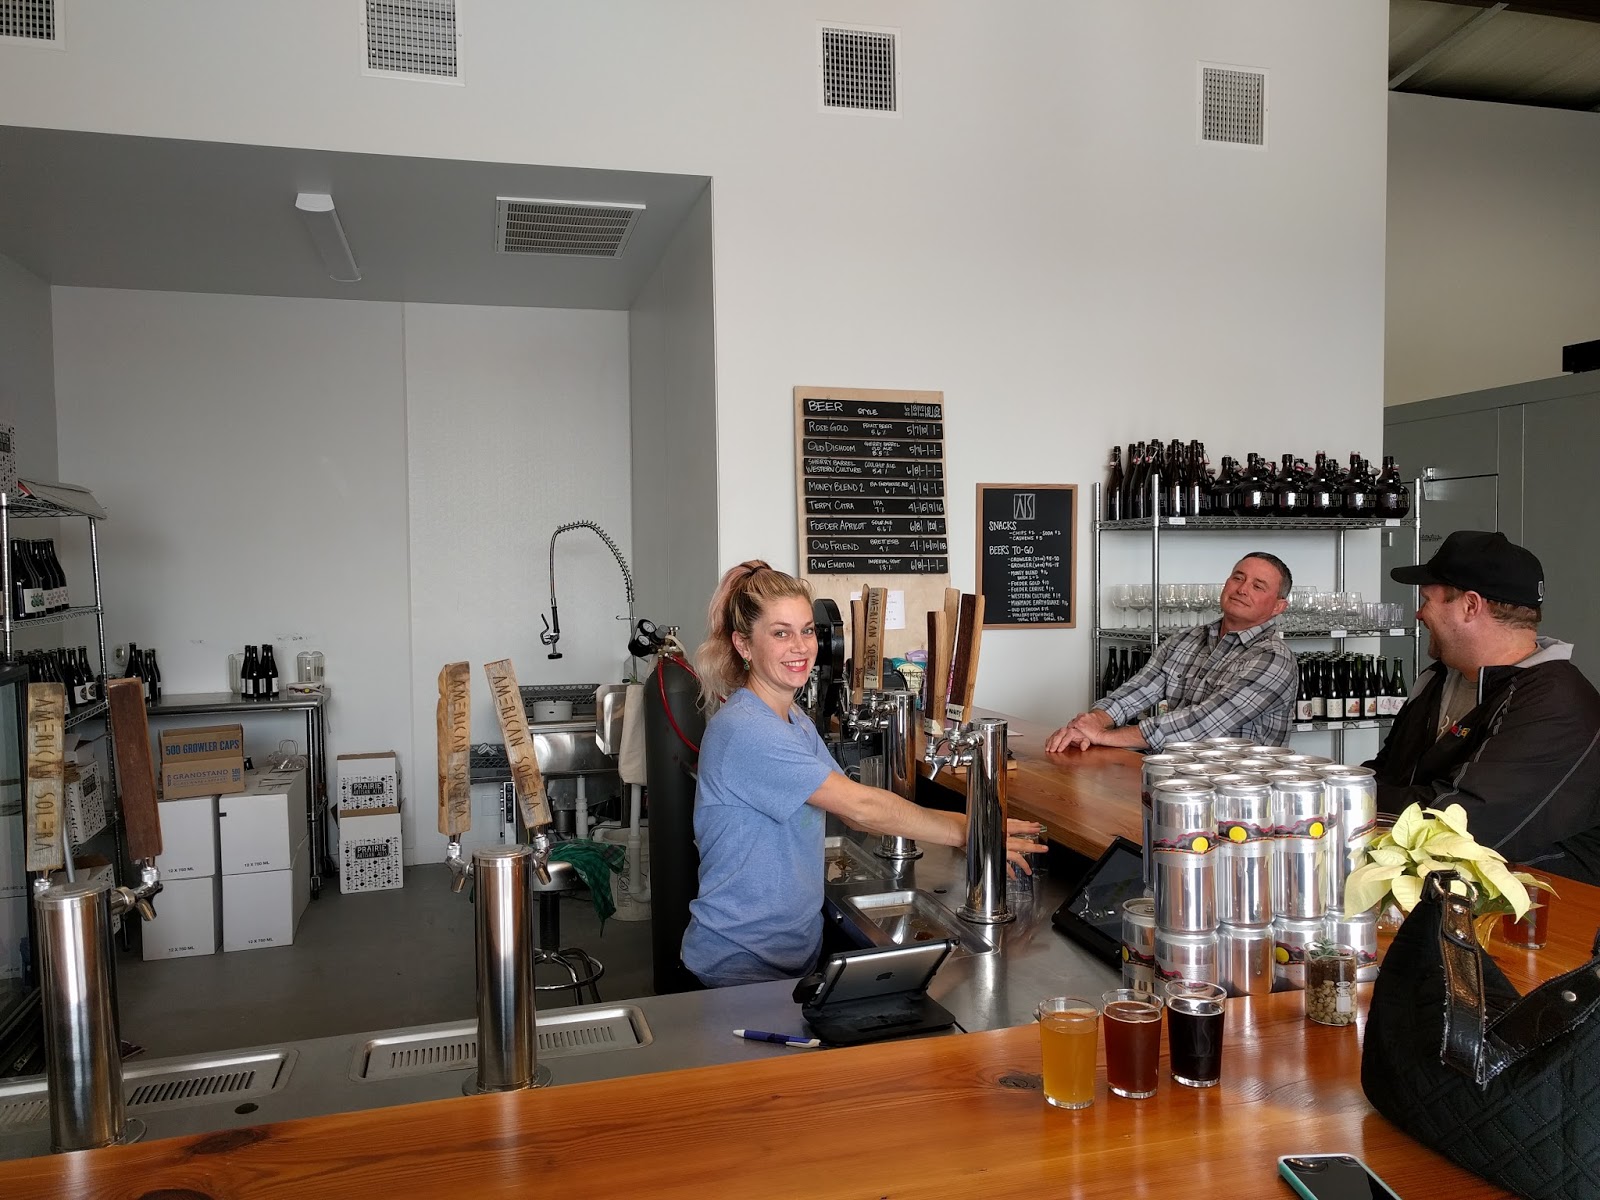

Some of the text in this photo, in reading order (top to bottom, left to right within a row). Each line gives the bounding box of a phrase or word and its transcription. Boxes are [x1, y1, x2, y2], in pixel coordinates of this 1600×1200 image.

[808, 401, 843, 411] BEER
[857, 408, 878, 416] STYLE
[809, 421, 848, 432] ROSE GOLD
[808, 482, 833, 491] MONEY
[834, 482, 858, 492] BLEND
[834, 500, 854, 510] CITRA
[810, 520, 867, 532] FOEDER APRICOT
[989, 521, 1017, 531] SNACKS
[830, 540, 859, 550] FRIEND
[989, 546, 1034, 554] BEERS TO-GO
[827, 559, 855, 569] EMOTION
[166, 740, 239, 755] 500 GROWLER CAPS
[492, 676, 541, 811] AMERICAN SOLERA
[452, 680, 467, 819] AMERICAN SOLERA
[35, 698, 55, 852] AMERICAN SOLERA
[173, 769, 228, 780] GRANDSTAND
[357, 845, 387, 853] PRAIRIE
